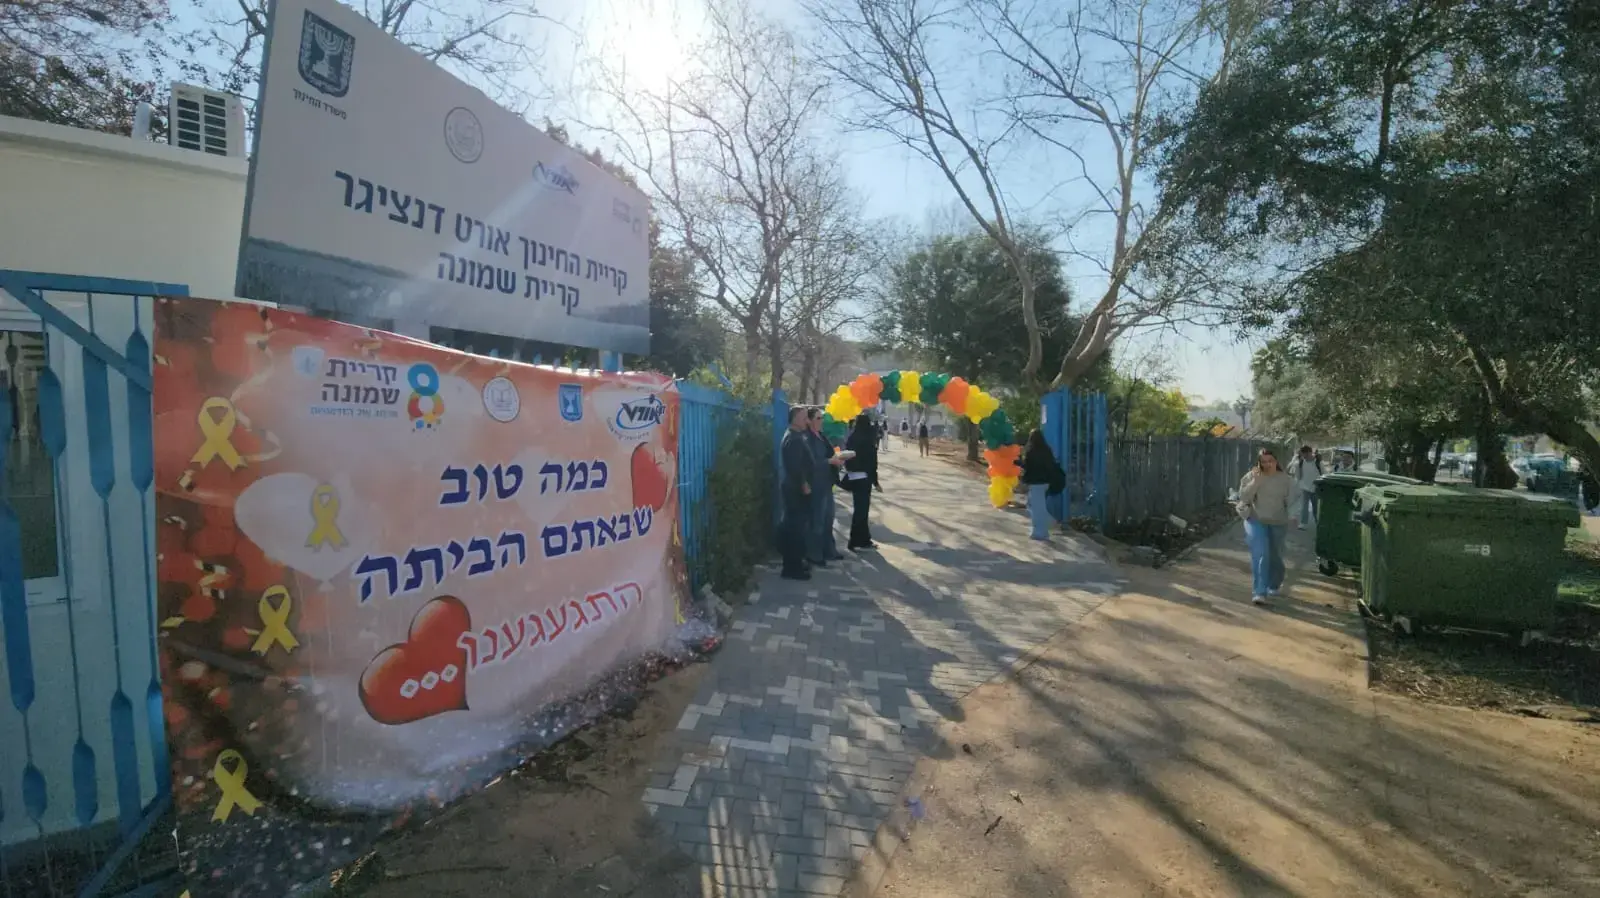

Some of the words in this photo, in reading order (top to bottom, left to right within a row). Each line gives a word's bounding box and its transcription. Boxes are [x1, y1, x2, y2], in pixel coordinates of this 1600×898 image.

[322, 101, 347, 120] משרד
[335, 169, 445, 234] דנציגר
[455, 213, 511, 256] אורט
[437, 251, 516, 294] שמונה
[518, 235, 580, 277] החינוך
[585, 258, 628, 296] קריית
[523, 275, 580, 316] קריית
[325, 358, 397, 385] קריית
[322, 383, 400, 405] שמונה
[439, 462, 524, 505] טוב
[538, 458, 608, 495] כמה
[540, 506, 653, 558] שבאתם
[355, 531, 527, 603] הביתה
